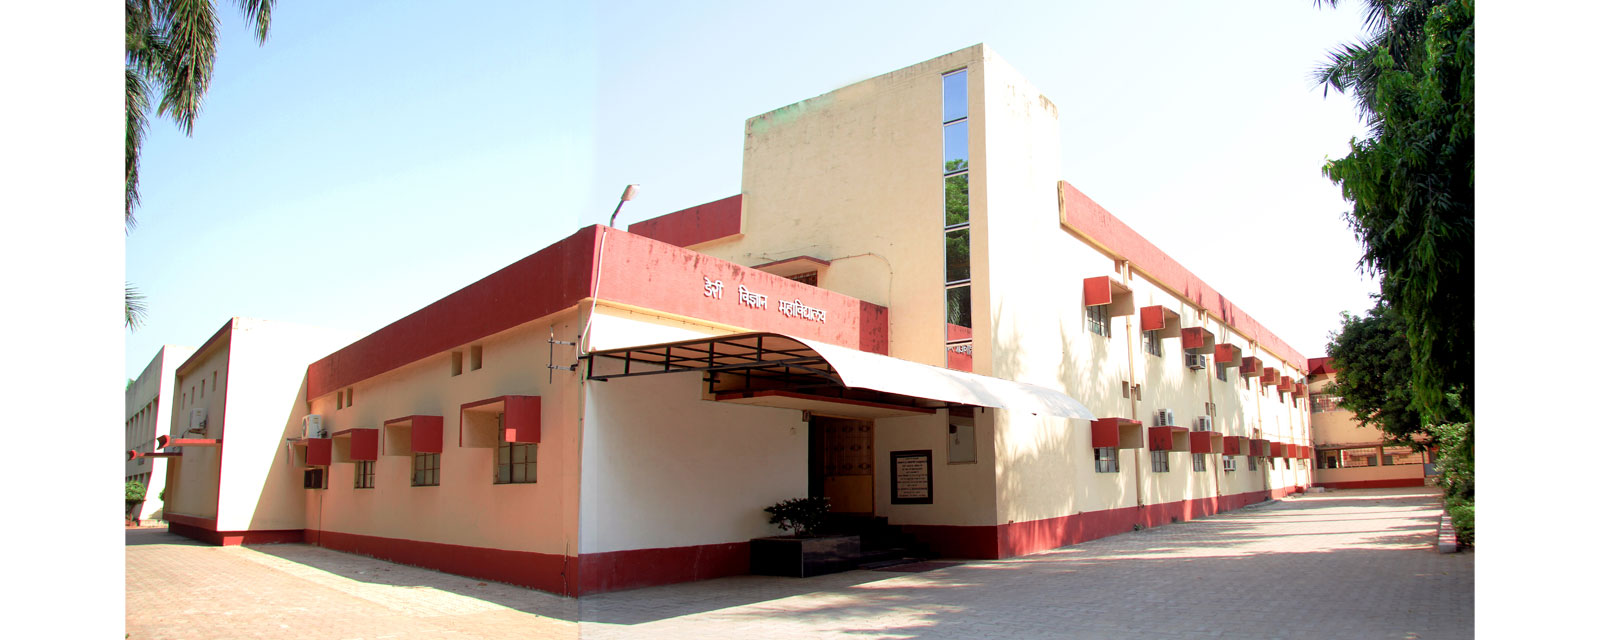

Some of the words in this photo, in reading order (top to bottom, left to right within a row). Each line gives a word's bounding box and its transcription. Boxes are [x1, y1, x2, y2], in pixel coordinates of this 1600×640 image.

[703, 275, 724, 300] डेरी
[738, 284, 768, 310] विज्ञान
[778, 298, 827, 324] महाविद्यालय
